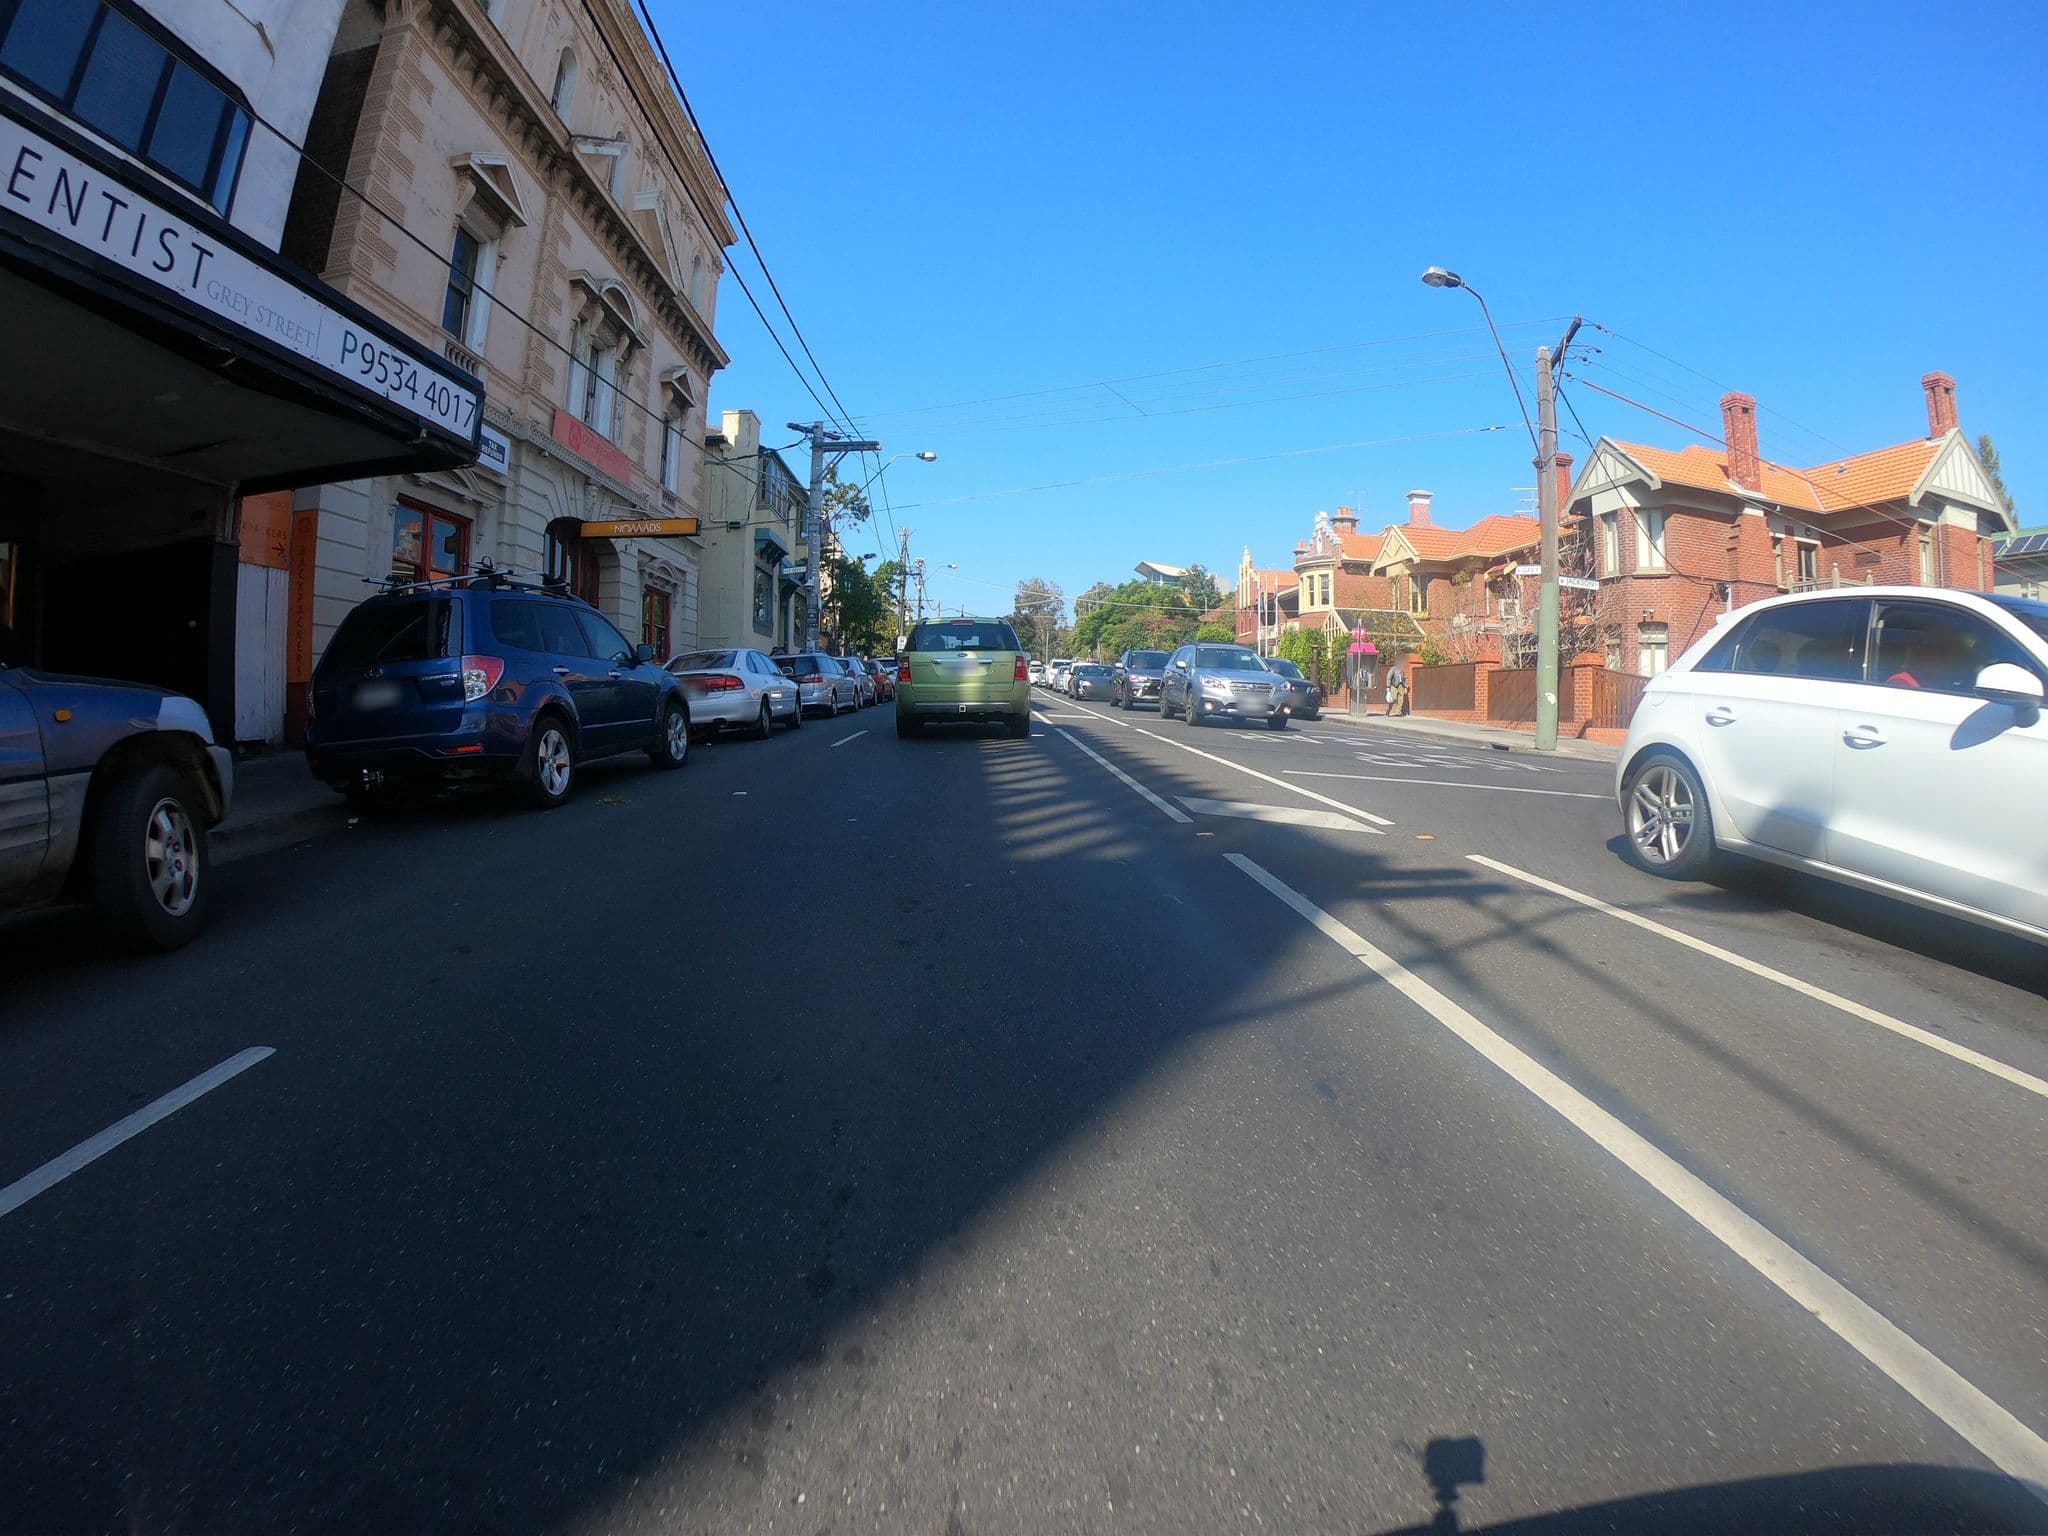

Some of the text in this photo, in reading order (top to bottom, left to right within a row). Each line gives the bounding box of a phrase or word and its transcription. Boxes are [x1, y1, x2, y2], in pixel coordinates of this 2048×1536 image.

[206, 279, 315, 348] GREY STREET
[423, 380, 477, 428] 4017
[614, 522, 662, 534] NOMADS
